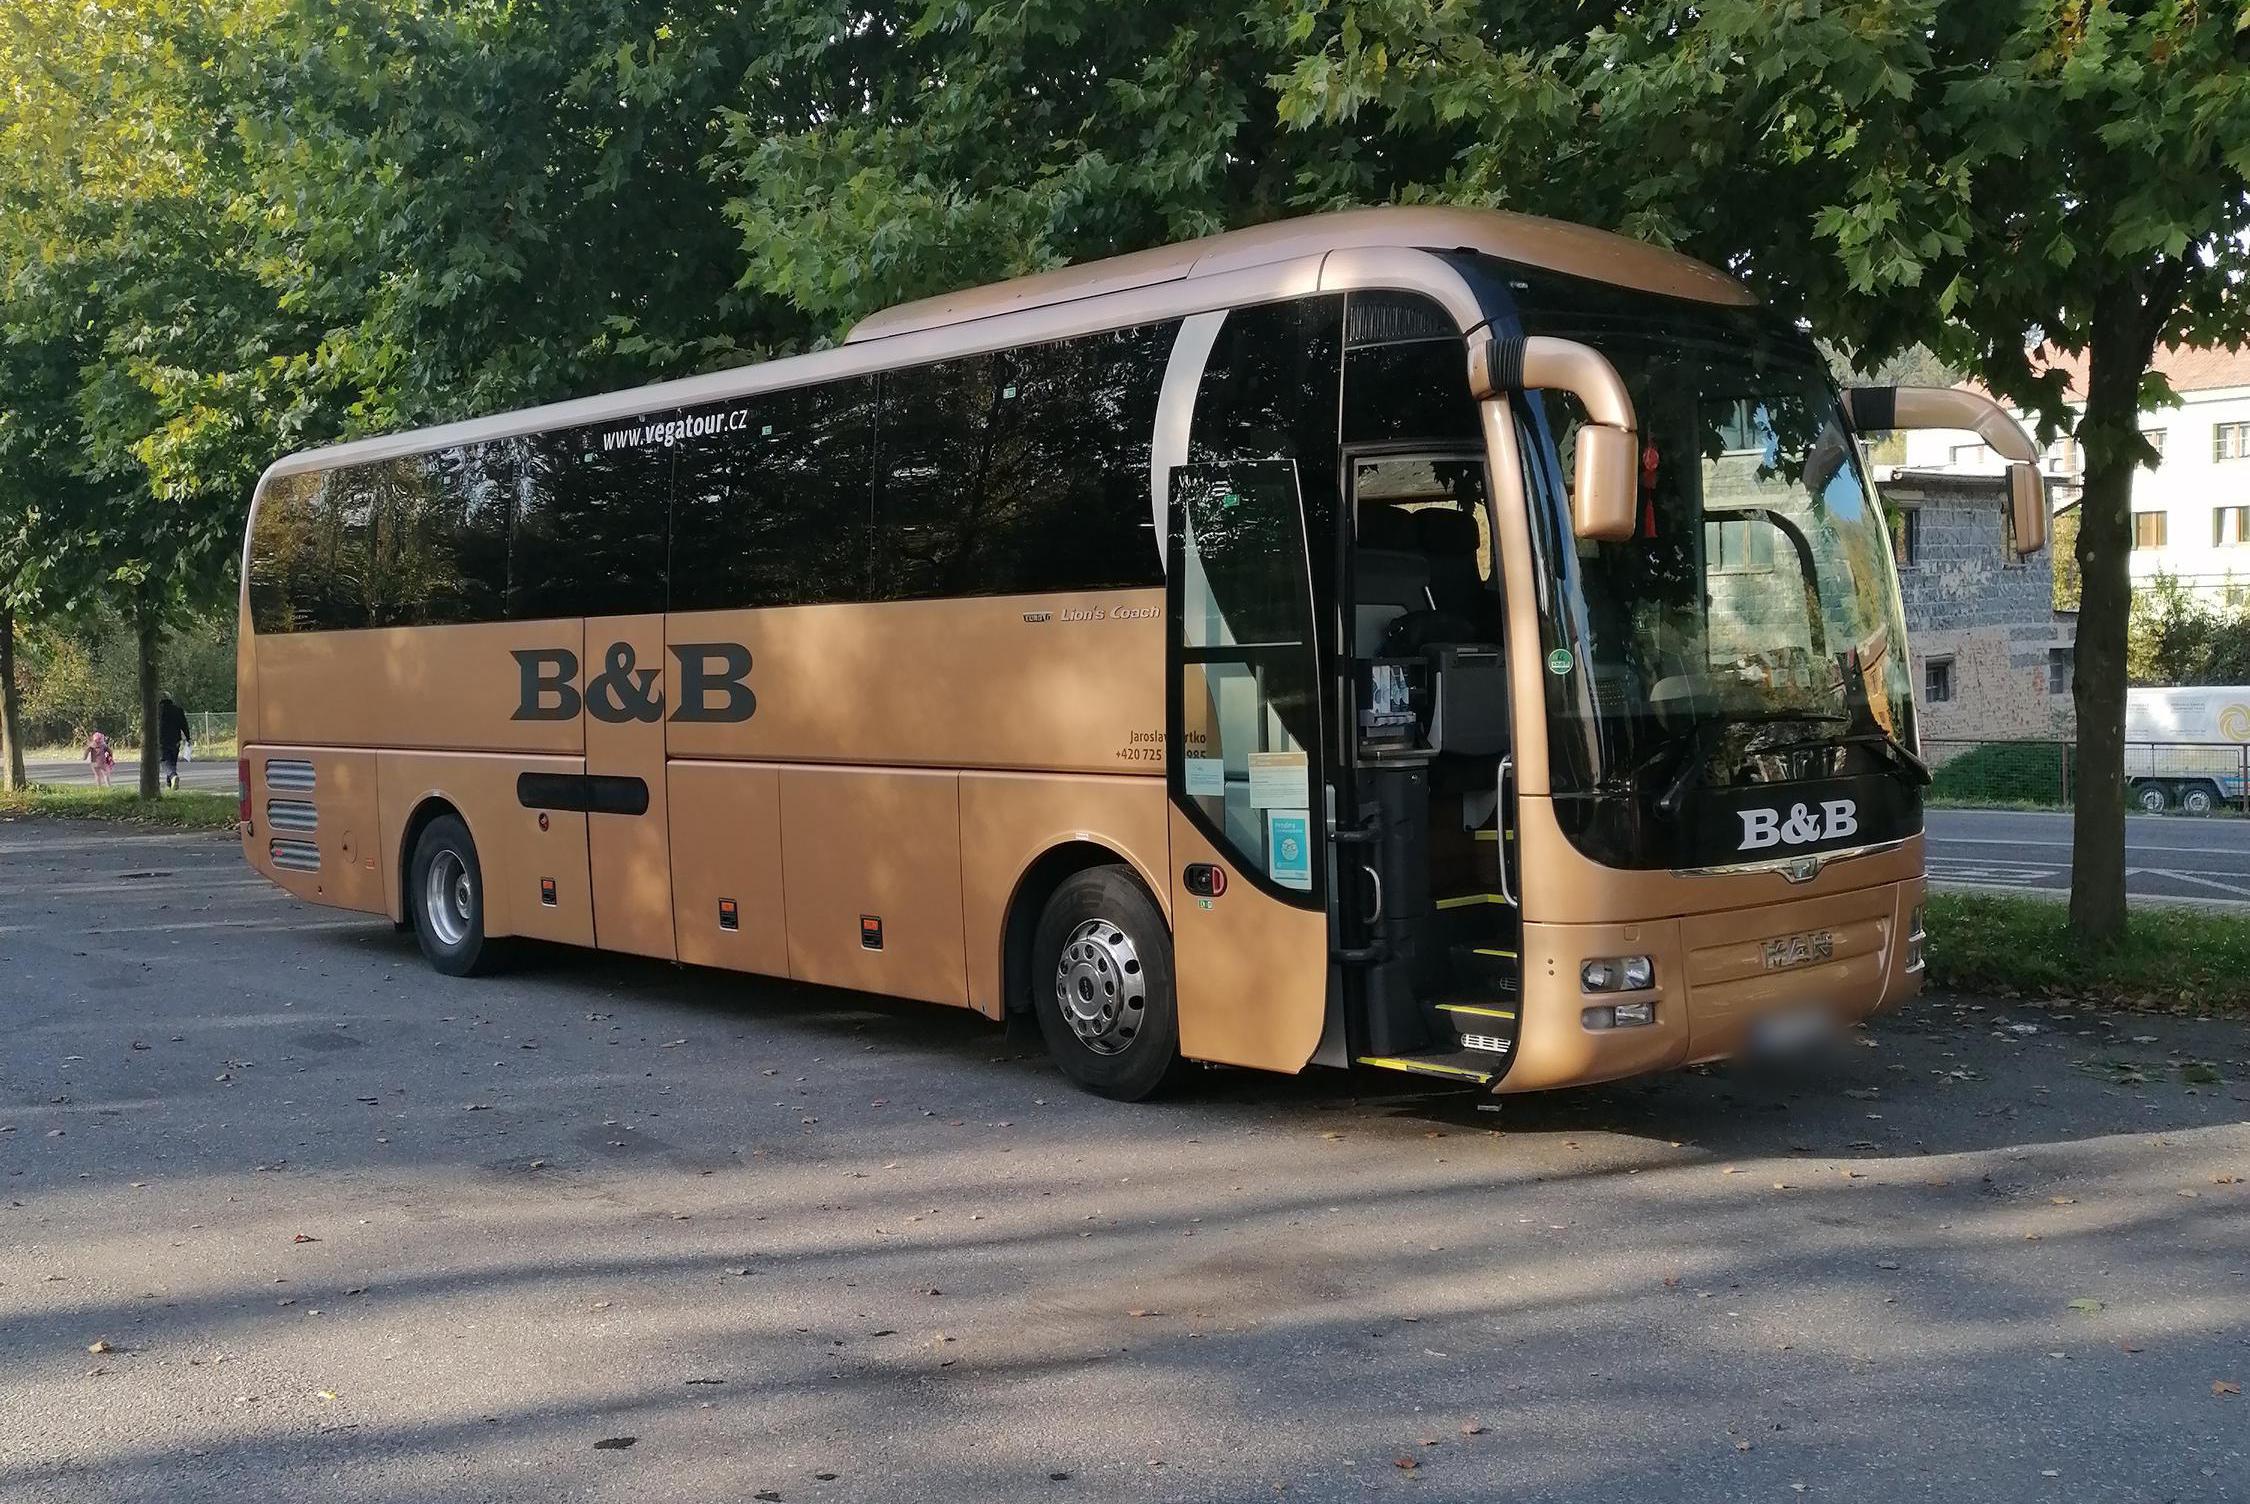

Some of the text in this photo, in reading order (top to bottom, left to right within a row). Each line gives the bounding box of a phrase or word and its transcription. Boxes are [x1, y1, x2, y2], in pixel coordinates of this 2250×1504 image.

[603, 409, 748, 451] www.vegatour.cz
[1060, 605, 1105, 621] Lion's
[1110, 604, 1160, 619] Coach
[509, 641, 757, 723] B&B
[1116, 748, 1140, 760] +420
[1143, 748, 1162, 760] 725
[1736, 799, 1858, 850] B&B
